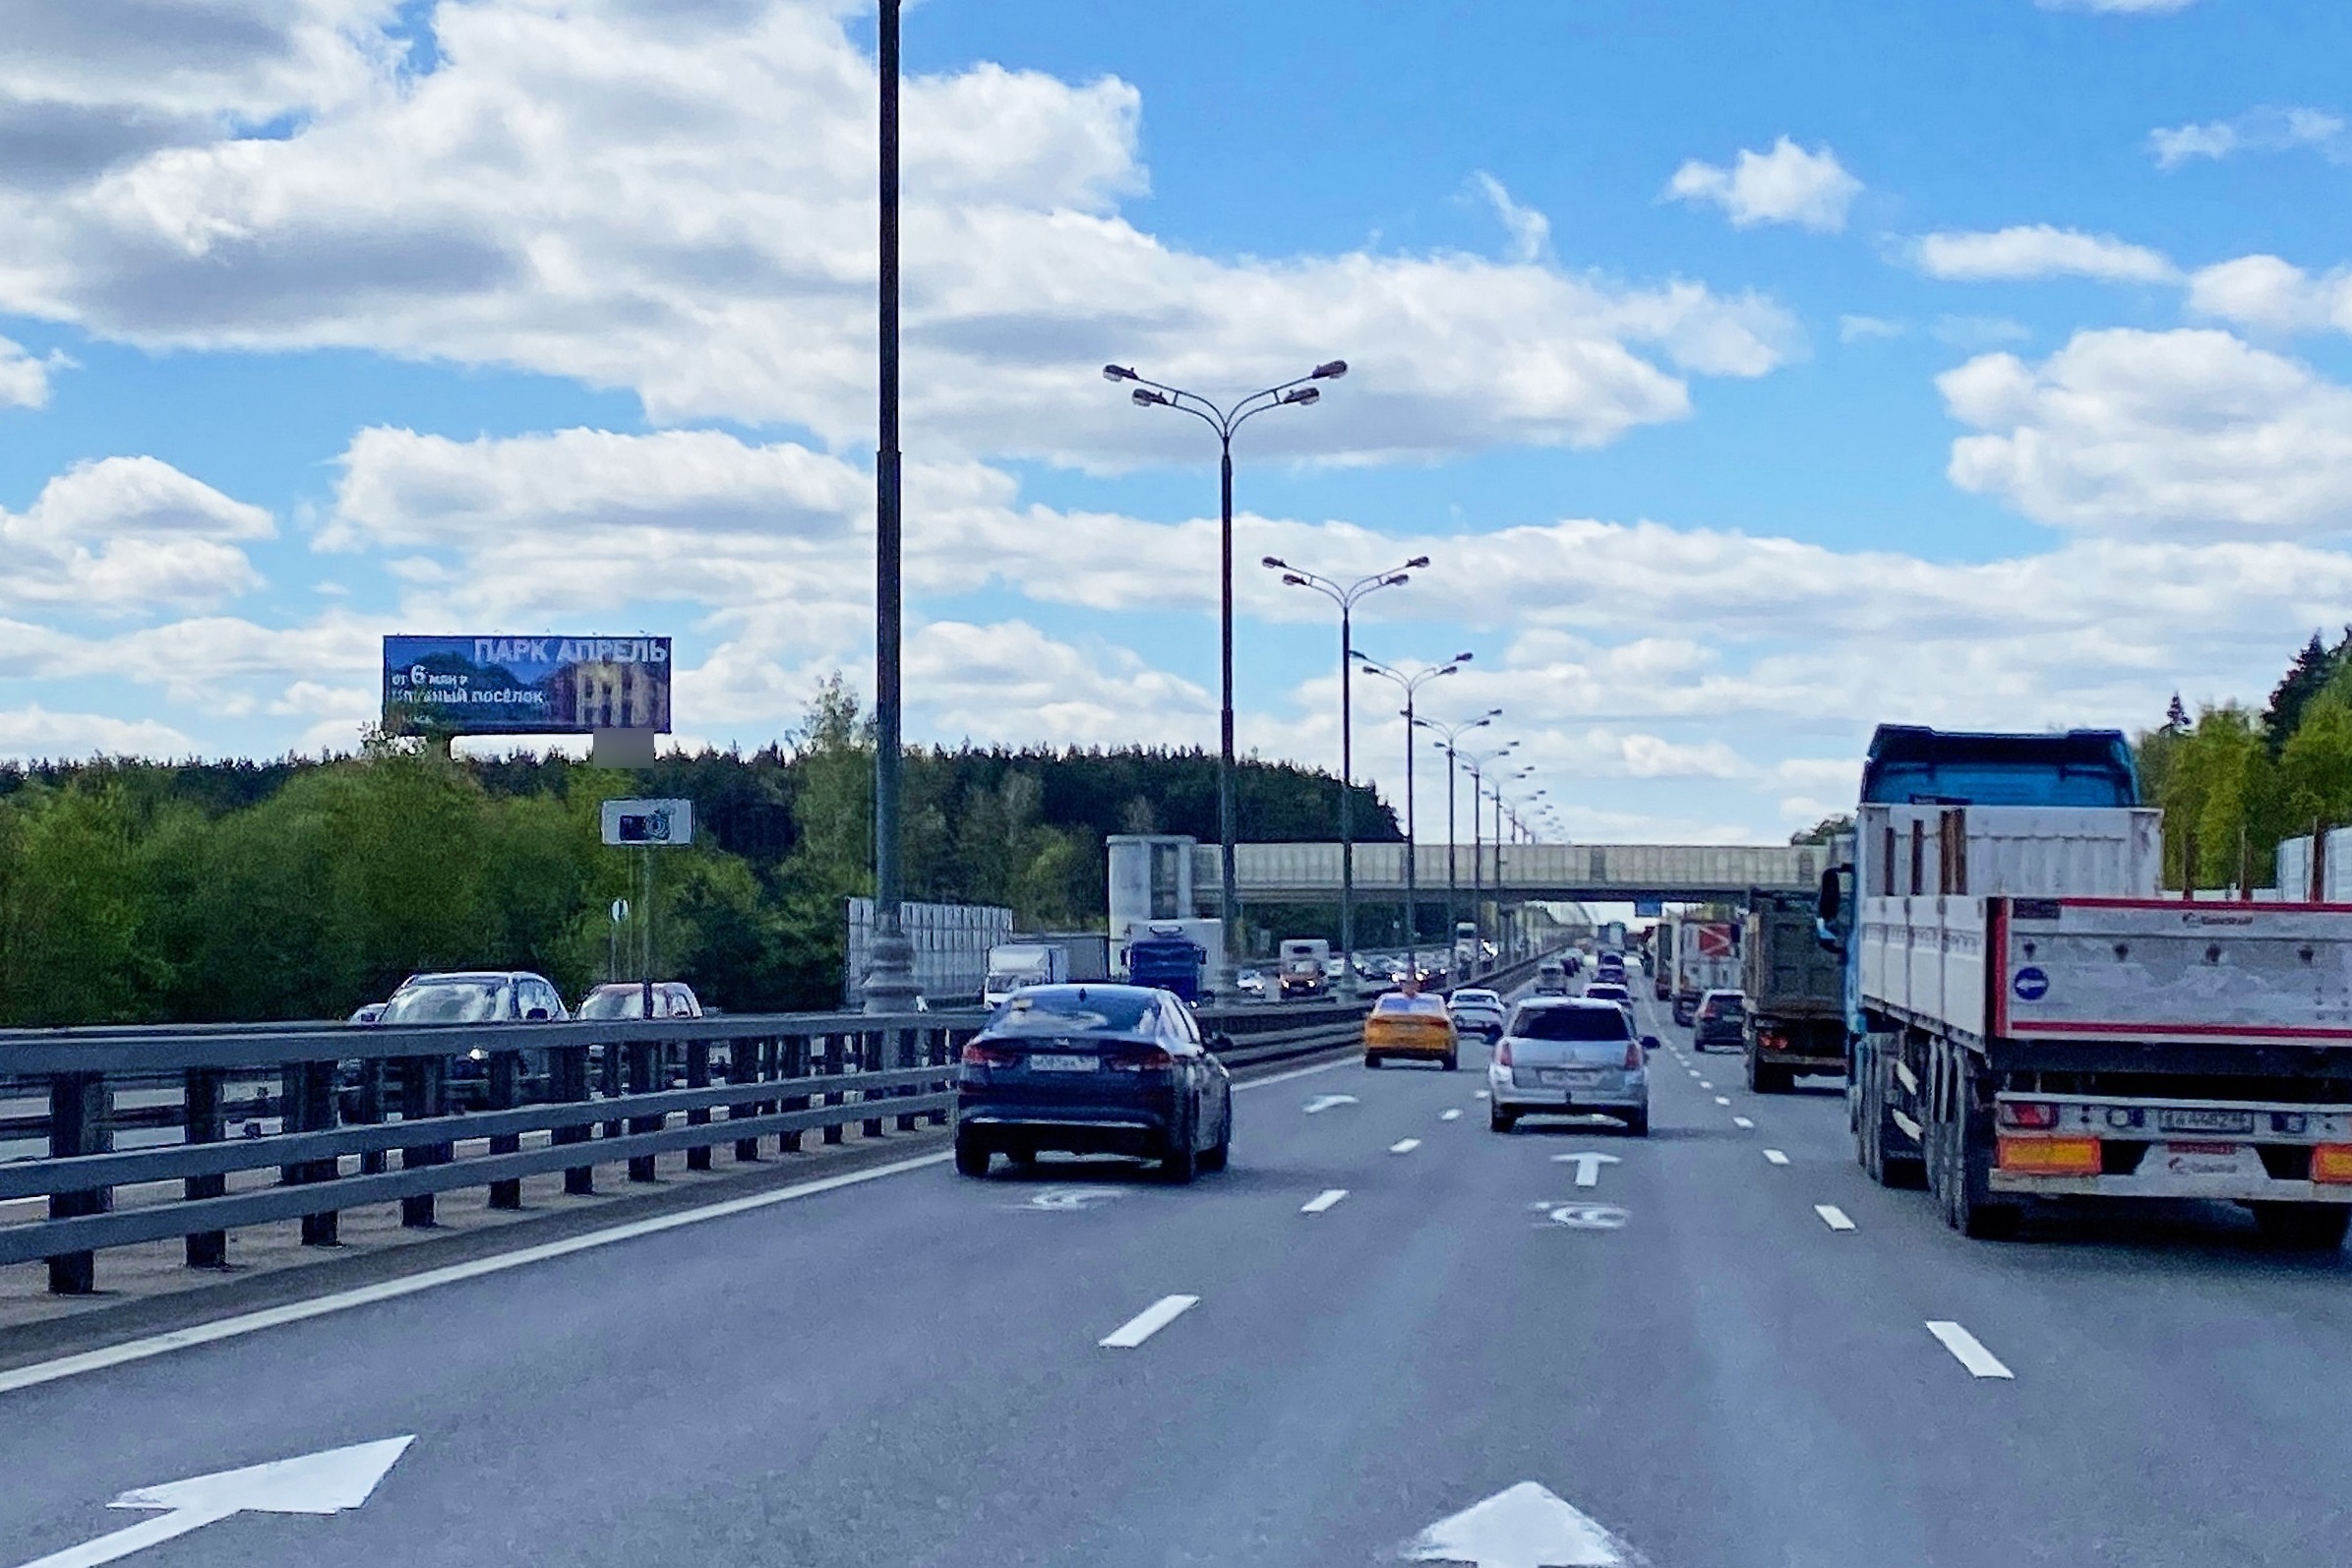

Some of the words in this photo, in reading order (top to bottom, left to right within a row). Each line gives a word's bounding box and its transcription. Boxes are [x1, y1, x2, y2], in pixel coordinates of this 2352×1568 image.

[474, 638, 547, 663] ПАРК
[556, 638, 668, 662] АПРЕЛЬ
[410, 664, 427, 685] 6
[471, 688, 544, 703] посёлок
